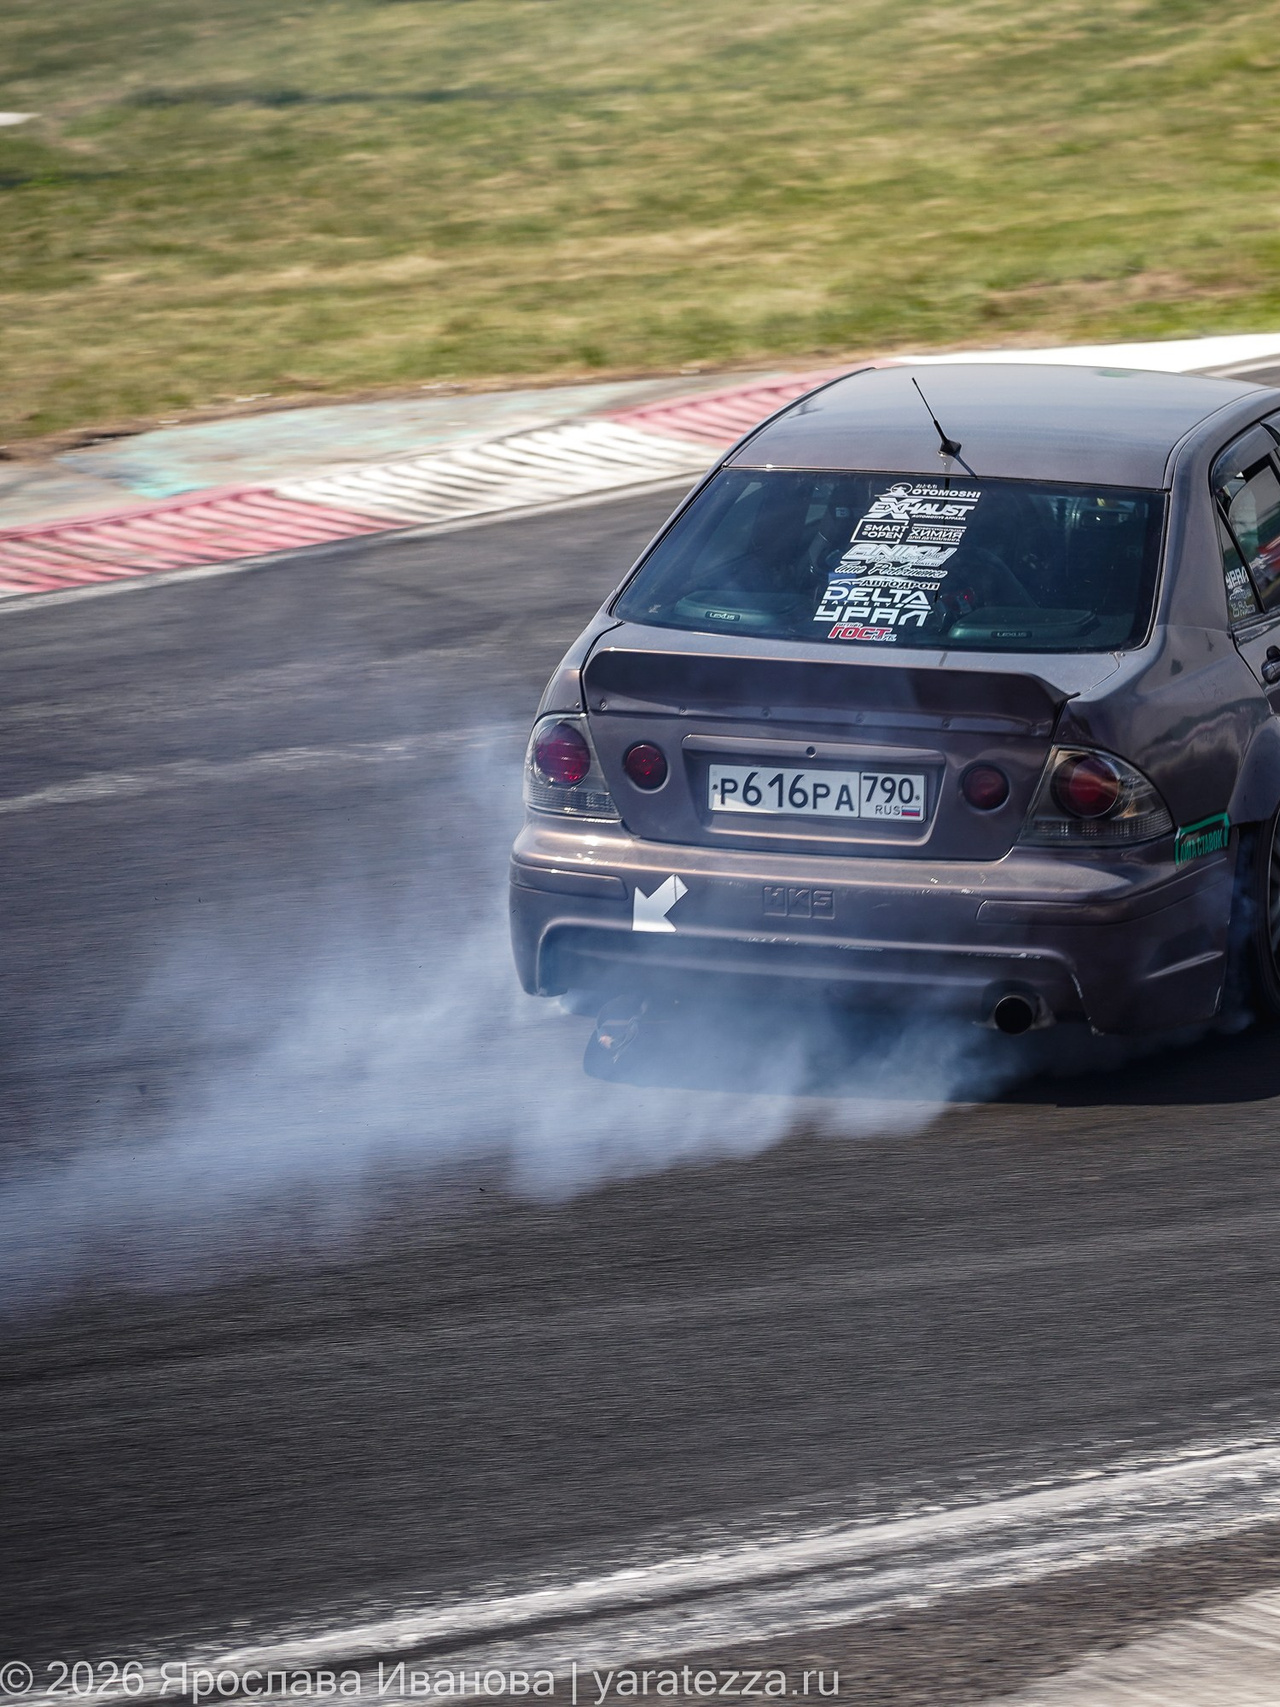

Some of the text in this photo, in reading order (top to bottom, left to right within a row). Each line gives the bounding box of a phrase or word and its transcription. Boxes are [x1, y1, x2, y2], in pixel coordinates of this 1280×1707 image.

[912, 489, 981, 498] OTOMOSHI
[863, 497, 975, 519] EXHAUST
[863, 524, 909, 532] SMART
[909, 529, 962, 539] ХИМИЯ
[821, 599, 891, 607] BATTERY
[823, 586, 931, 610] DELTA
[813, 605, 928, 627] УРАЛ
[828, 626, 893, 640] ГОСТ
[863, 775, 914, 804] 790
[875, 804, 900, 816] RUS
